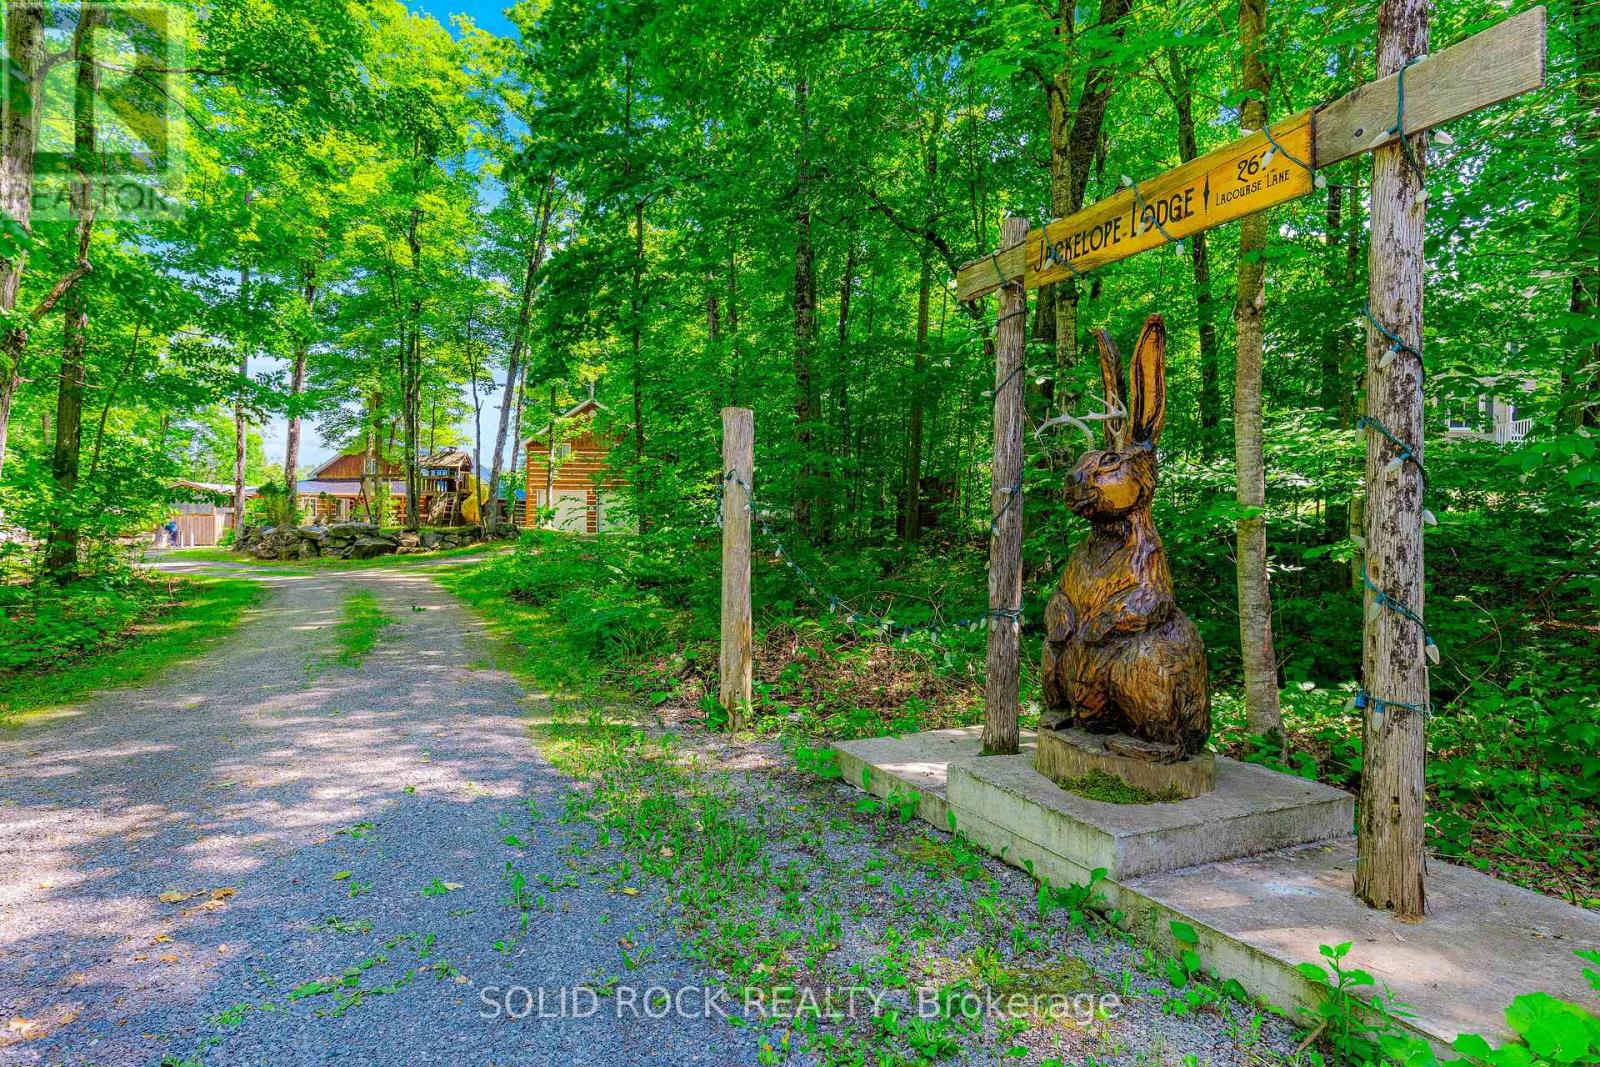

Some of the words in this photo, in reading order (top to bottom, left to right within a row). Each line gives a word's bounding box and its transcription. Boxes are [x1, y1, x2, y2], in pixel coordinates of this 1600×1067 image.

[1215, 180, 1262, 206] LACOURSE
[1266, 169, 1290, 187] LANE
[1131, 187, 1195, 238] LODGE
